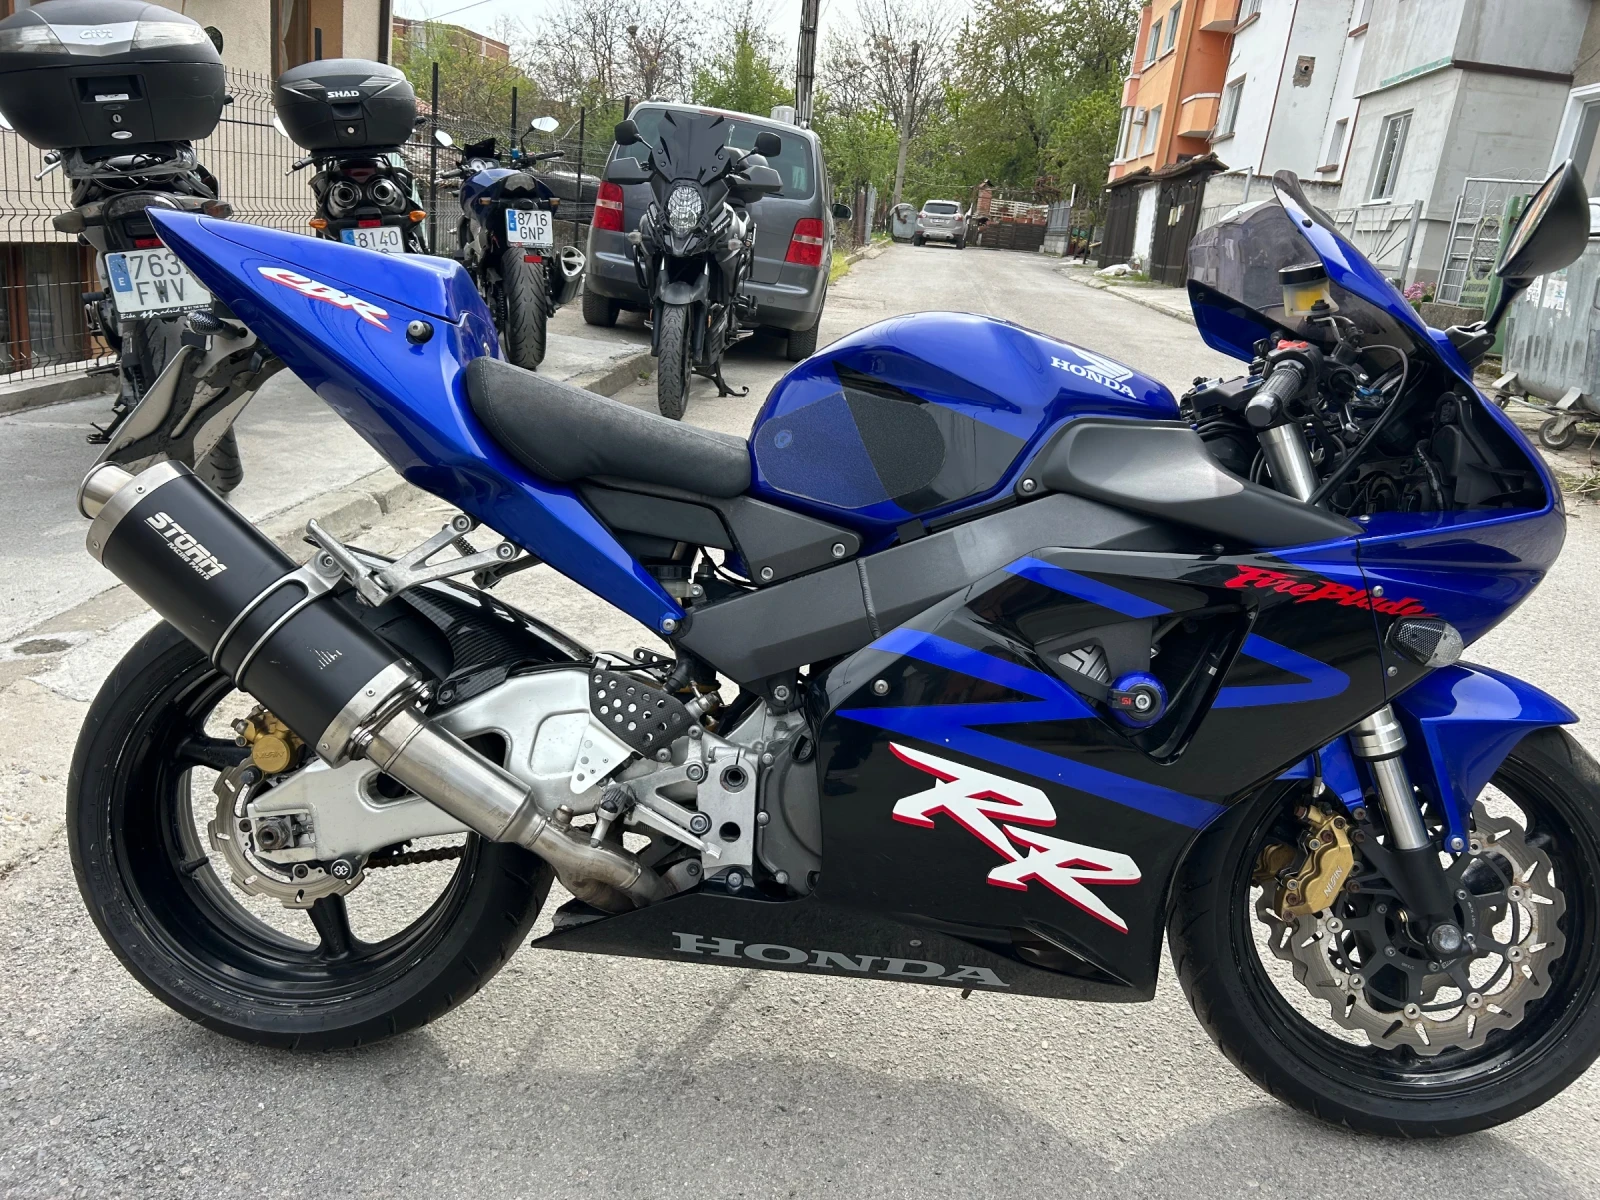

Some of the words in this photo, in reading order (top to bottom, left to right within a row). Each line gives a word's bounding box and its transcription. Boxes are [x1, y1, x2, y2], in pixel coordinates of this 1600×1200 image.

[80, 29, 113, 40] GIVI
[327, 90, 360, 99] SHAD
[517, 212, 548, 227] 8716
[358, 230, 399, 248] 8140
[519, 226, 545, 241] GNP
[129, 253, 189, 280] 763
[118, 277, 126, 287] E
[136, 277, 184, 306] FWV
[257, 266, 393, 334] CBR
[1050, 355, 1137, 399] HONDA
[145, 511, 228, 578] STORM
[189, 560, 212, 581] PARTS
[888, 741, 1142, 935] RR
[671, 931, 1011, 987] HONDA
